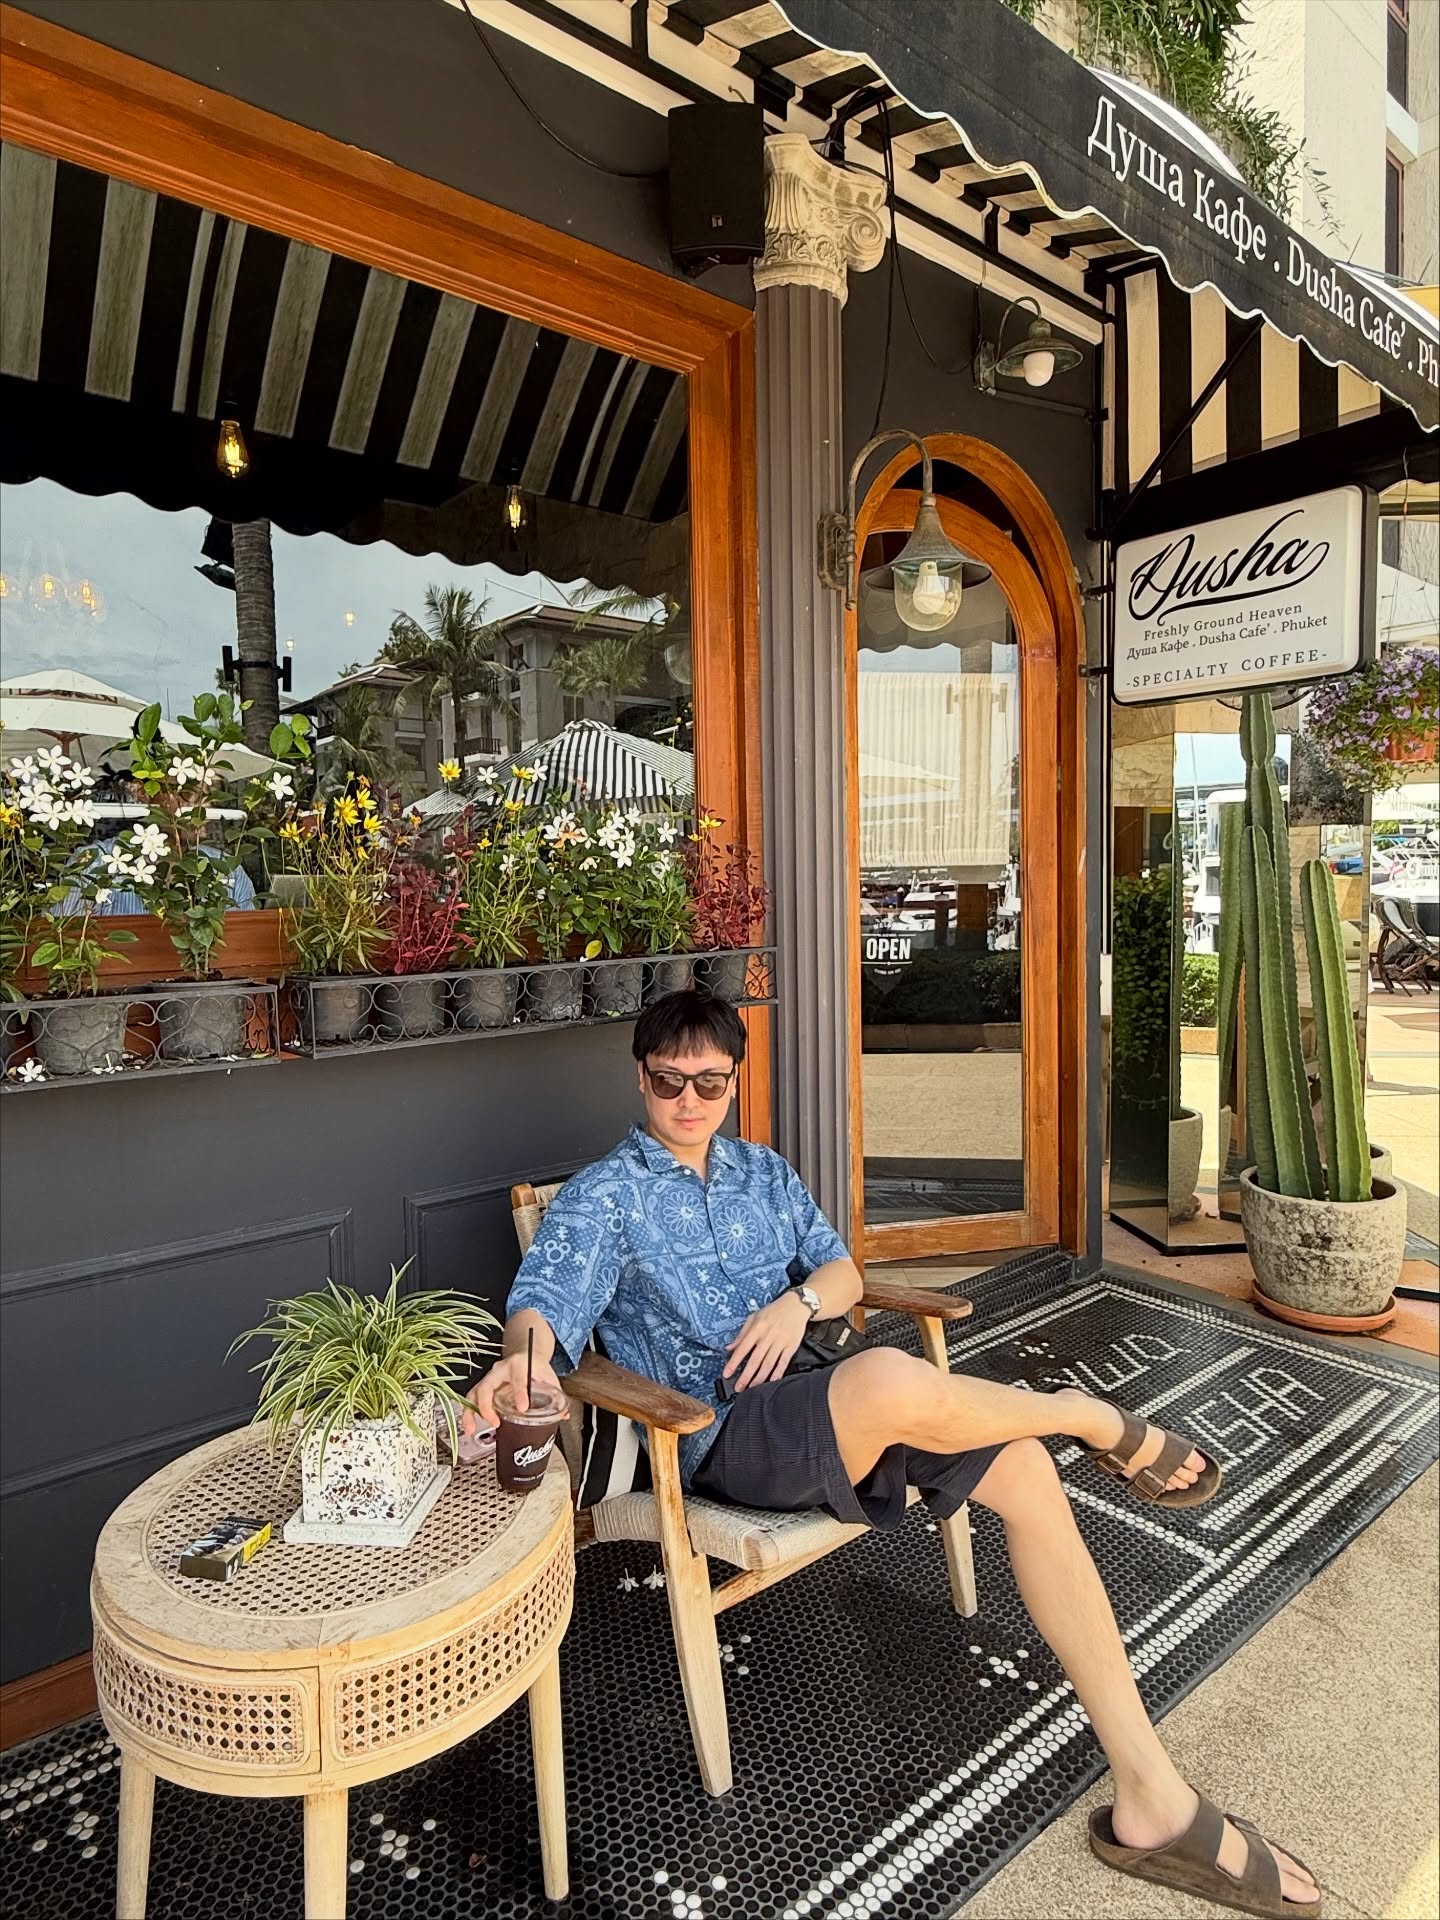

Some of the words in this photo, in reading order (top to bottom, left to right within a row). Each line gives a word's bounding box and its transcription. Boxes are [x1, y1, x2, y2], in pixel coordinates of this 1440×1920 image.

[1087, 95, 1185, 208] Душа
[1193, 168, 1266, 265] Кафе
[1286, 236, 1356, 328] Dusha
[1128, 509, 1330, 626] Dusha
[1127, 645, 1157, 661] Душа
[1160, 637, 1189, 654] Кафе
[1199, 630, 1236, 647] Dusha
[1281, 615, 1328, 633] Phuket
[1143, 623, 1190, 641] Freshly
[1193, 612, 1243, 632] Ground
[1249, 604, 1302, 622] Heaven
[866, 937, 911, 960] OPEN
